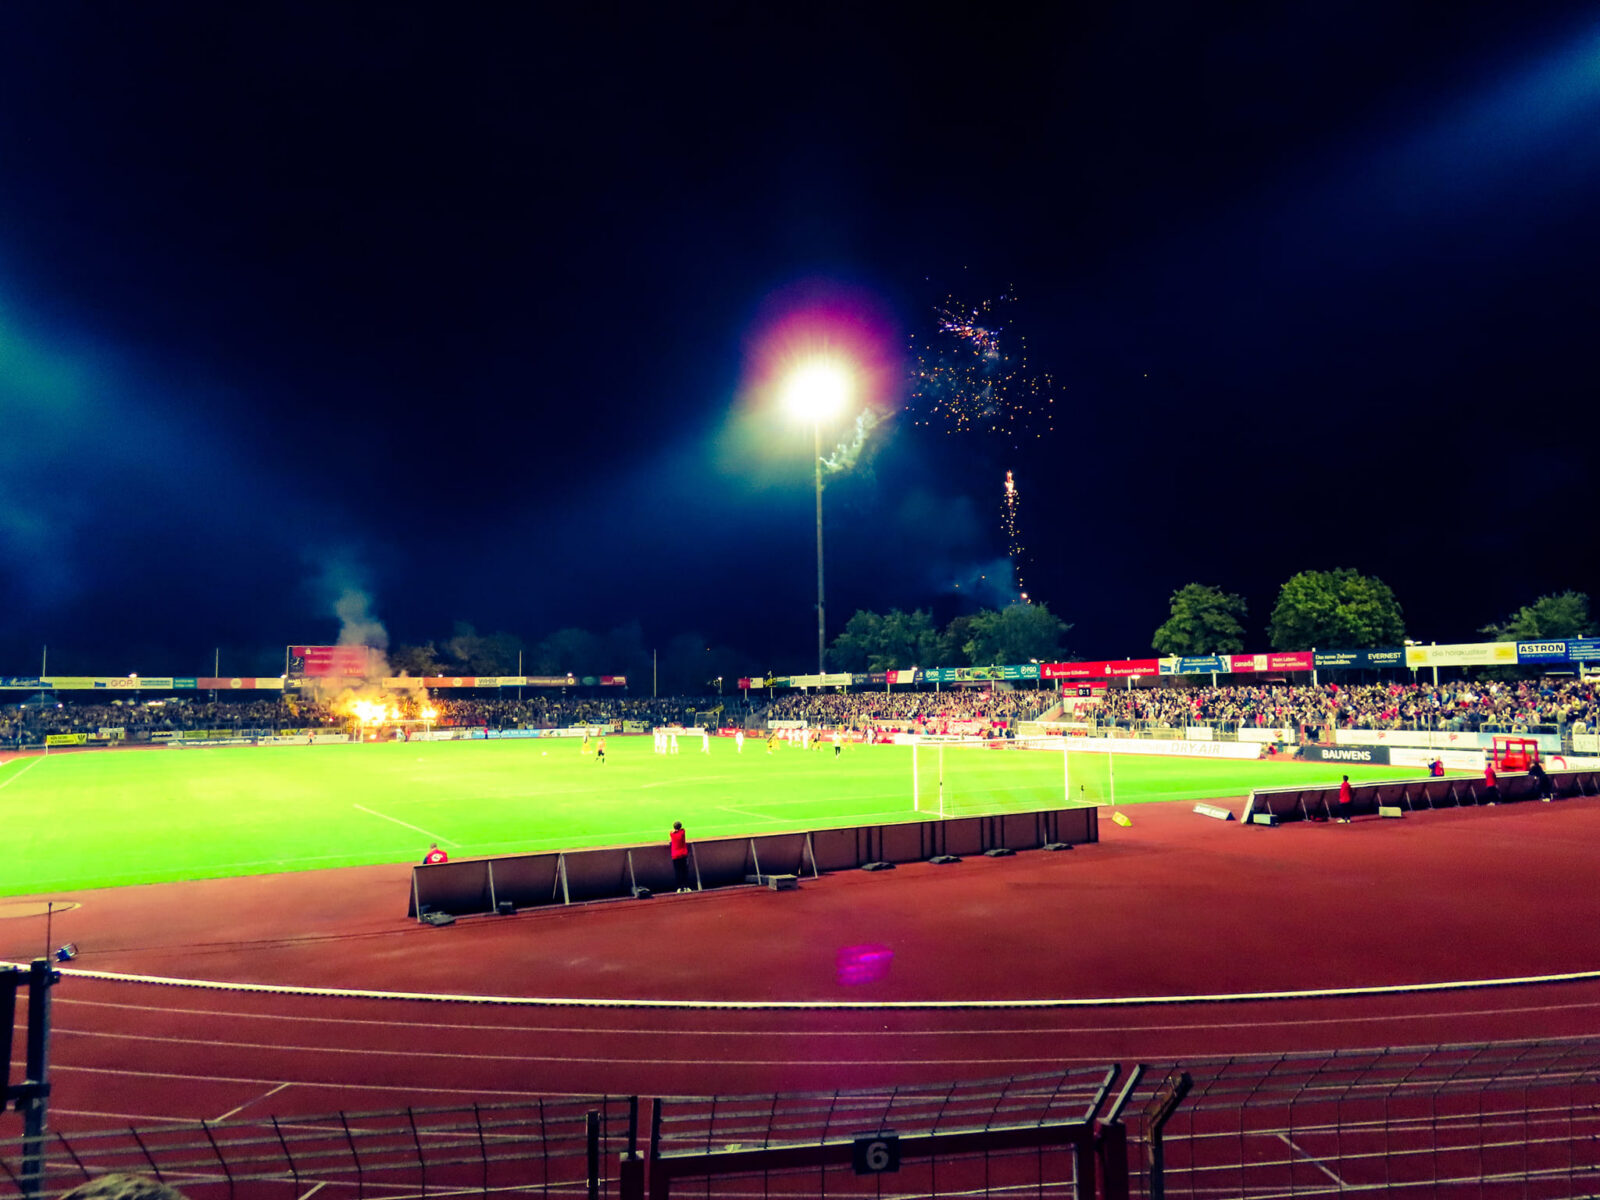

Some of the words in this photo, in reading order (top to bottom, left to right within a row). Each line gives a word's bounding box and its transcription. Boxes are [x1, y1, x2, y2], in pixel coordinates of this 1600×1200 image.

[1520, 644, 1564, 653] ASTRON
[1367, 652, 1402, 660] EVERNEST
[1321, 749, 1372, 761] BAUWENS
[865, 1141, 889, 1170] 6
